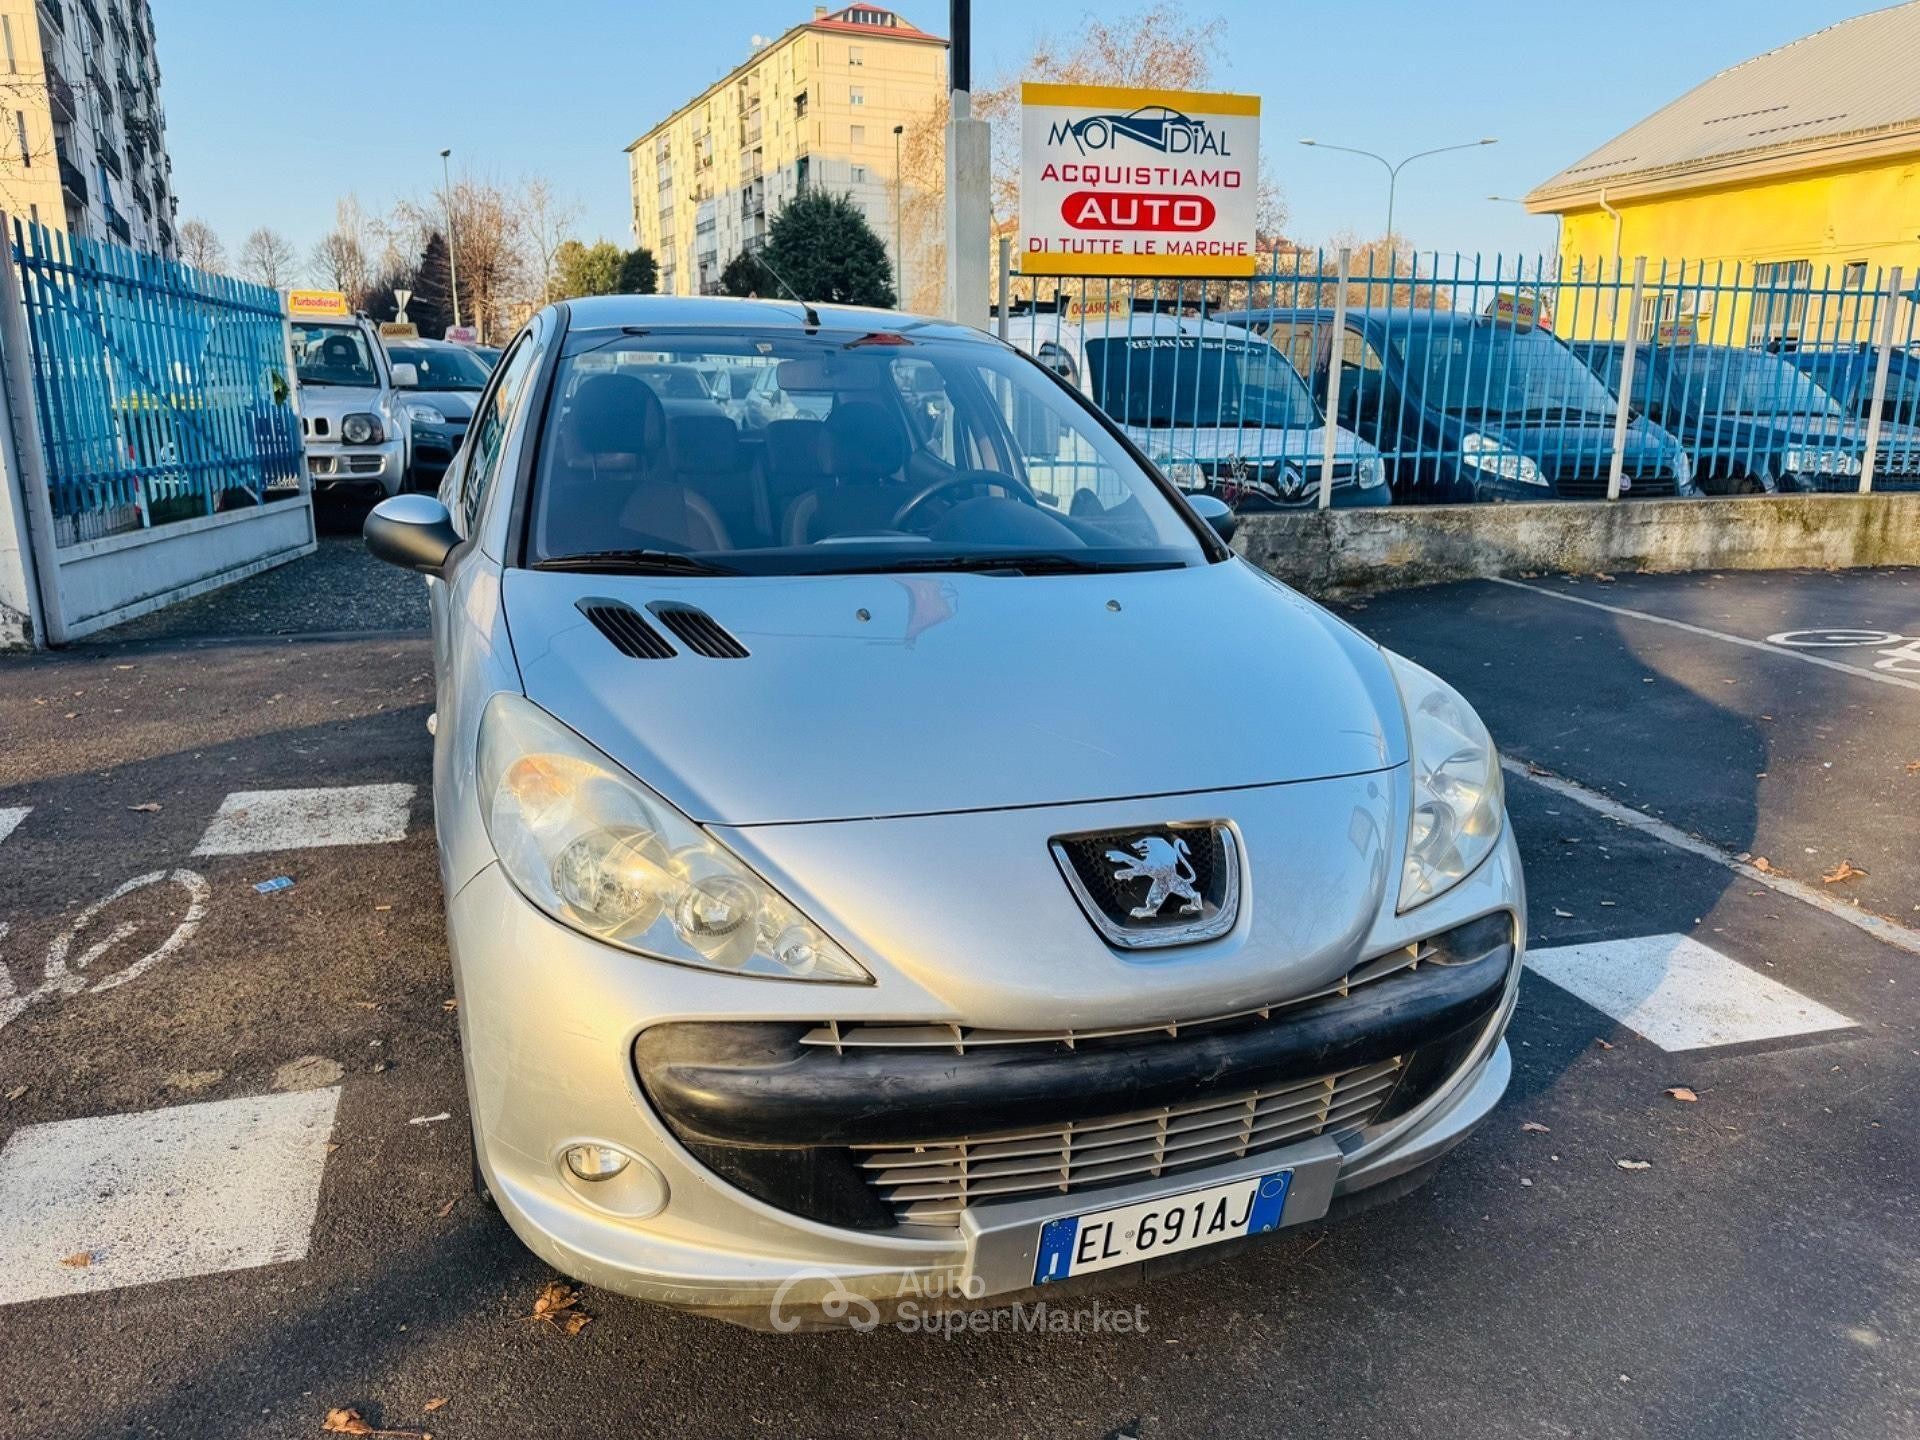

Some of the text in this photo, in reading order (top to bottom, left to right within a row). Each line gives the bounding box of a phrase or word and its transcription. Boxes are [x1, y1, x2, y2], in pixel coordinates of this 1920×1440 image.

[1040, 163, 1241, 188] ACQUISTIAMO
[1075, 197, 1203, 227] AUTO
[1029, 237, 1248, 256] DI TUTTE LE MARCHE
[292, 296, 341, 308] Turbodiesel
[1125, 339, 1196, 350] RENAULT
[1076, 1190, 1257, 1264] EL 691AJ
